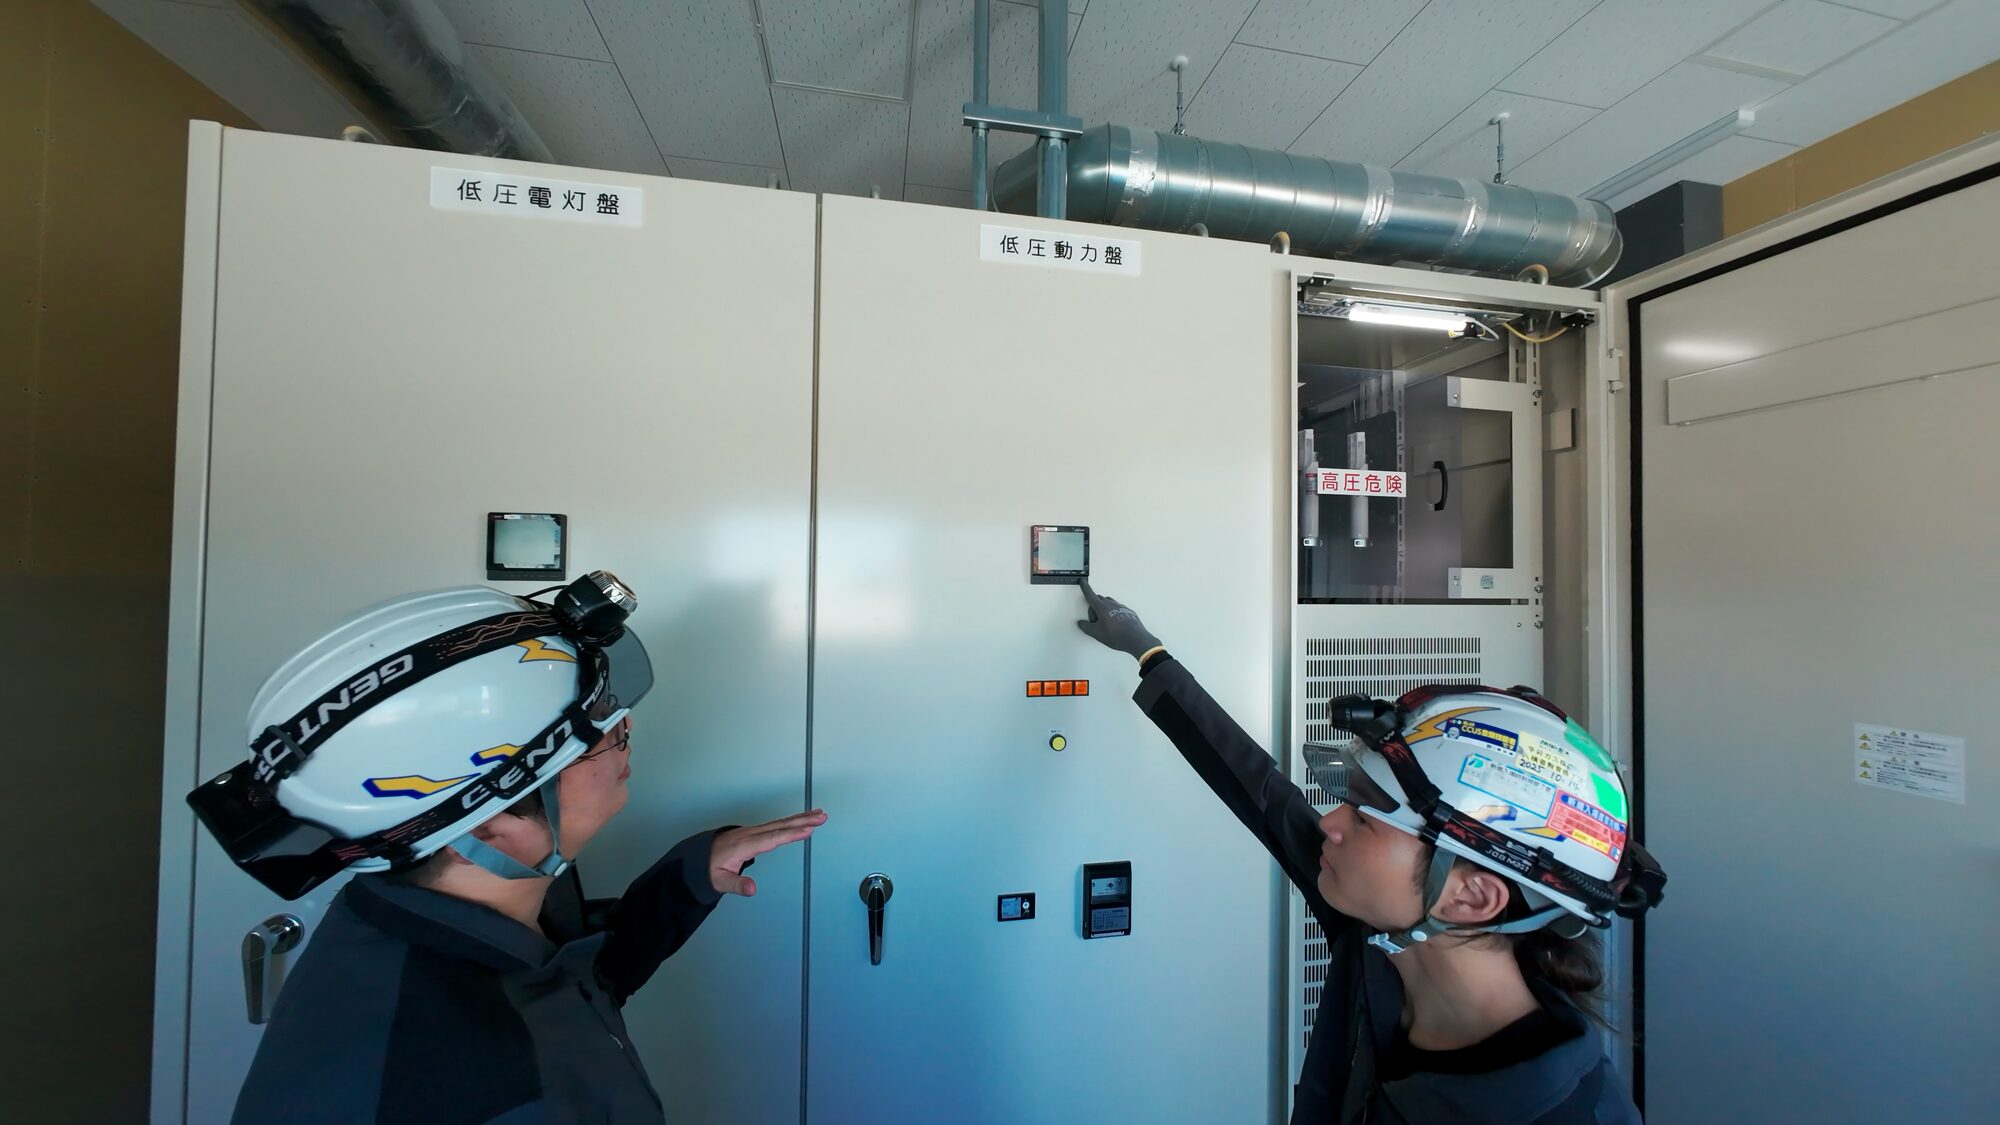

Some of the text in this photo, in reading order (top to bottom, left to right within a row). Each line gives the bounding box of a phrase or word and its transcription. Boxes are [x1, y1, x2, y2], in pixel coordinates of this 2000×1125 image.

[456, 179, 620, 216] 低圧電灯盤
[1000, 235, 1122, 265] 低圧動力盤
[1322, 472, 1402, 494] 高圧危険
